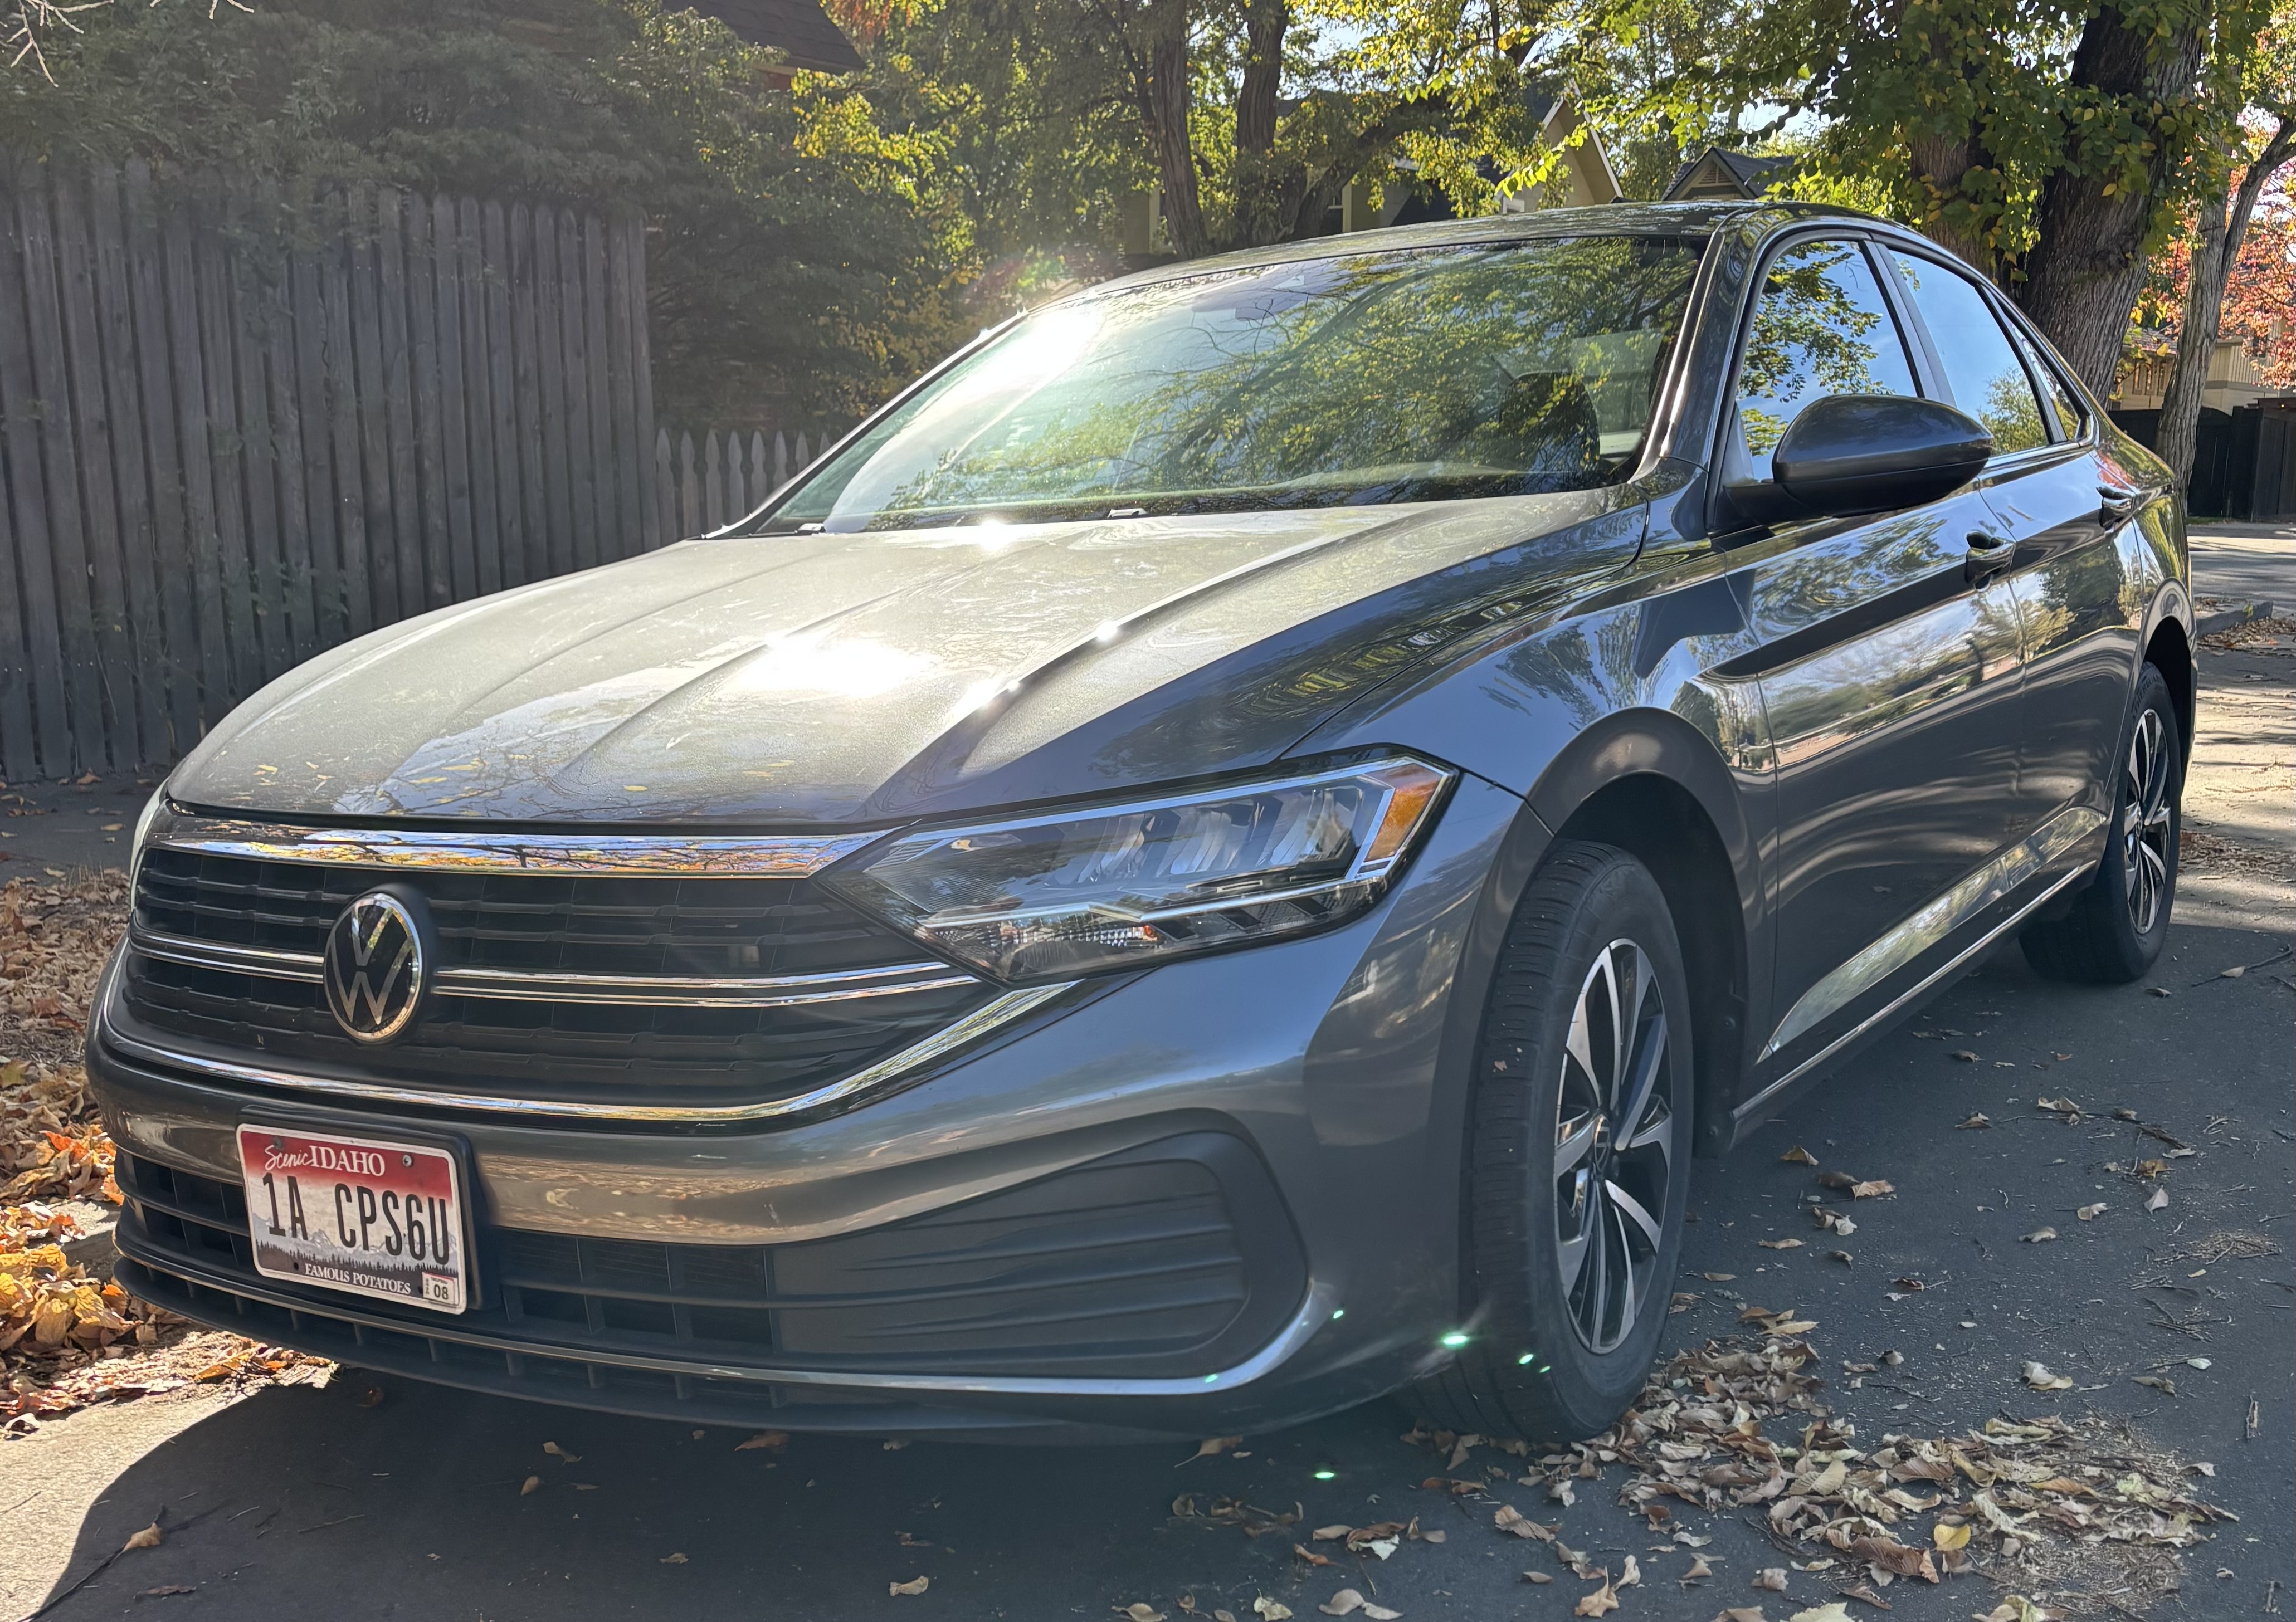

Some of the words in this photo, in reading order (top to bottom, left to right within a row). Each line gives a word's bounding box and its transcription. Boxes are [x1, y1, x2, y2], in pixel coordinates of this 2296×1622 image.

[265, 1145, 313, 1171] Scenic
[309, 1145, 386, 1176] IDAHO
[262, 1172, 308, 1241] 1A
[334, 1183, 449, 1266] CPS6U
[305, 1263, 350, 1282] FAMOUS
[353, 1272, 411, 1295] POTATOES
[433, 1284, 449, 1301] 08
